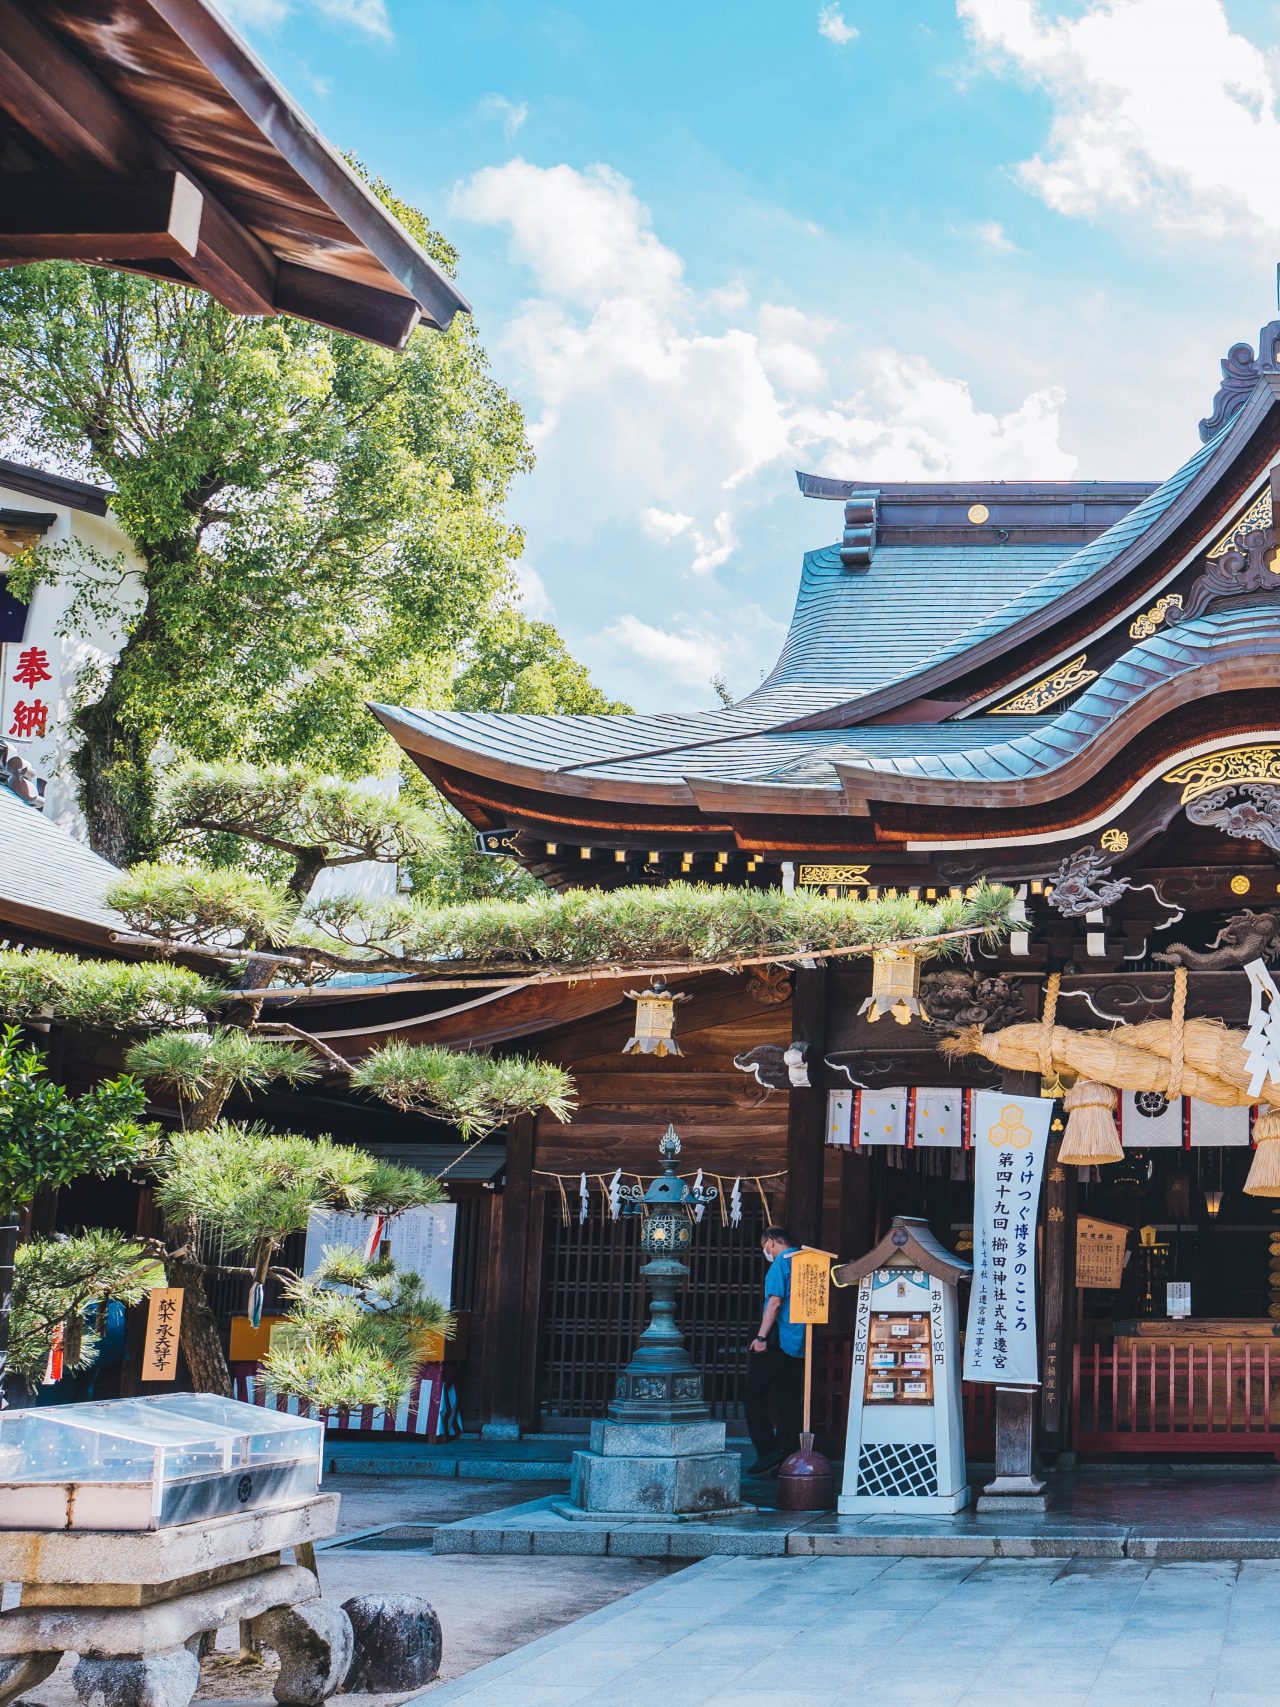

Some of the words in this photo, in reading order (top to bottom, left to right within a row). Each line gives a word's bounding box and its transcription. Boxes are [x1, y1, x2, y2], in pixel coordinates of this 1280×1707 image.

[8, 646, 53, 738] 奉納
[1048, 1167, 1065, 1222] 奉納
[1014, 1151, 1034, 1331] うけつぐ博多のこころ
[854, 1290, 870, 1366] おみくじ100円
[931, 1290, 945, 1366] おみくじ100円
